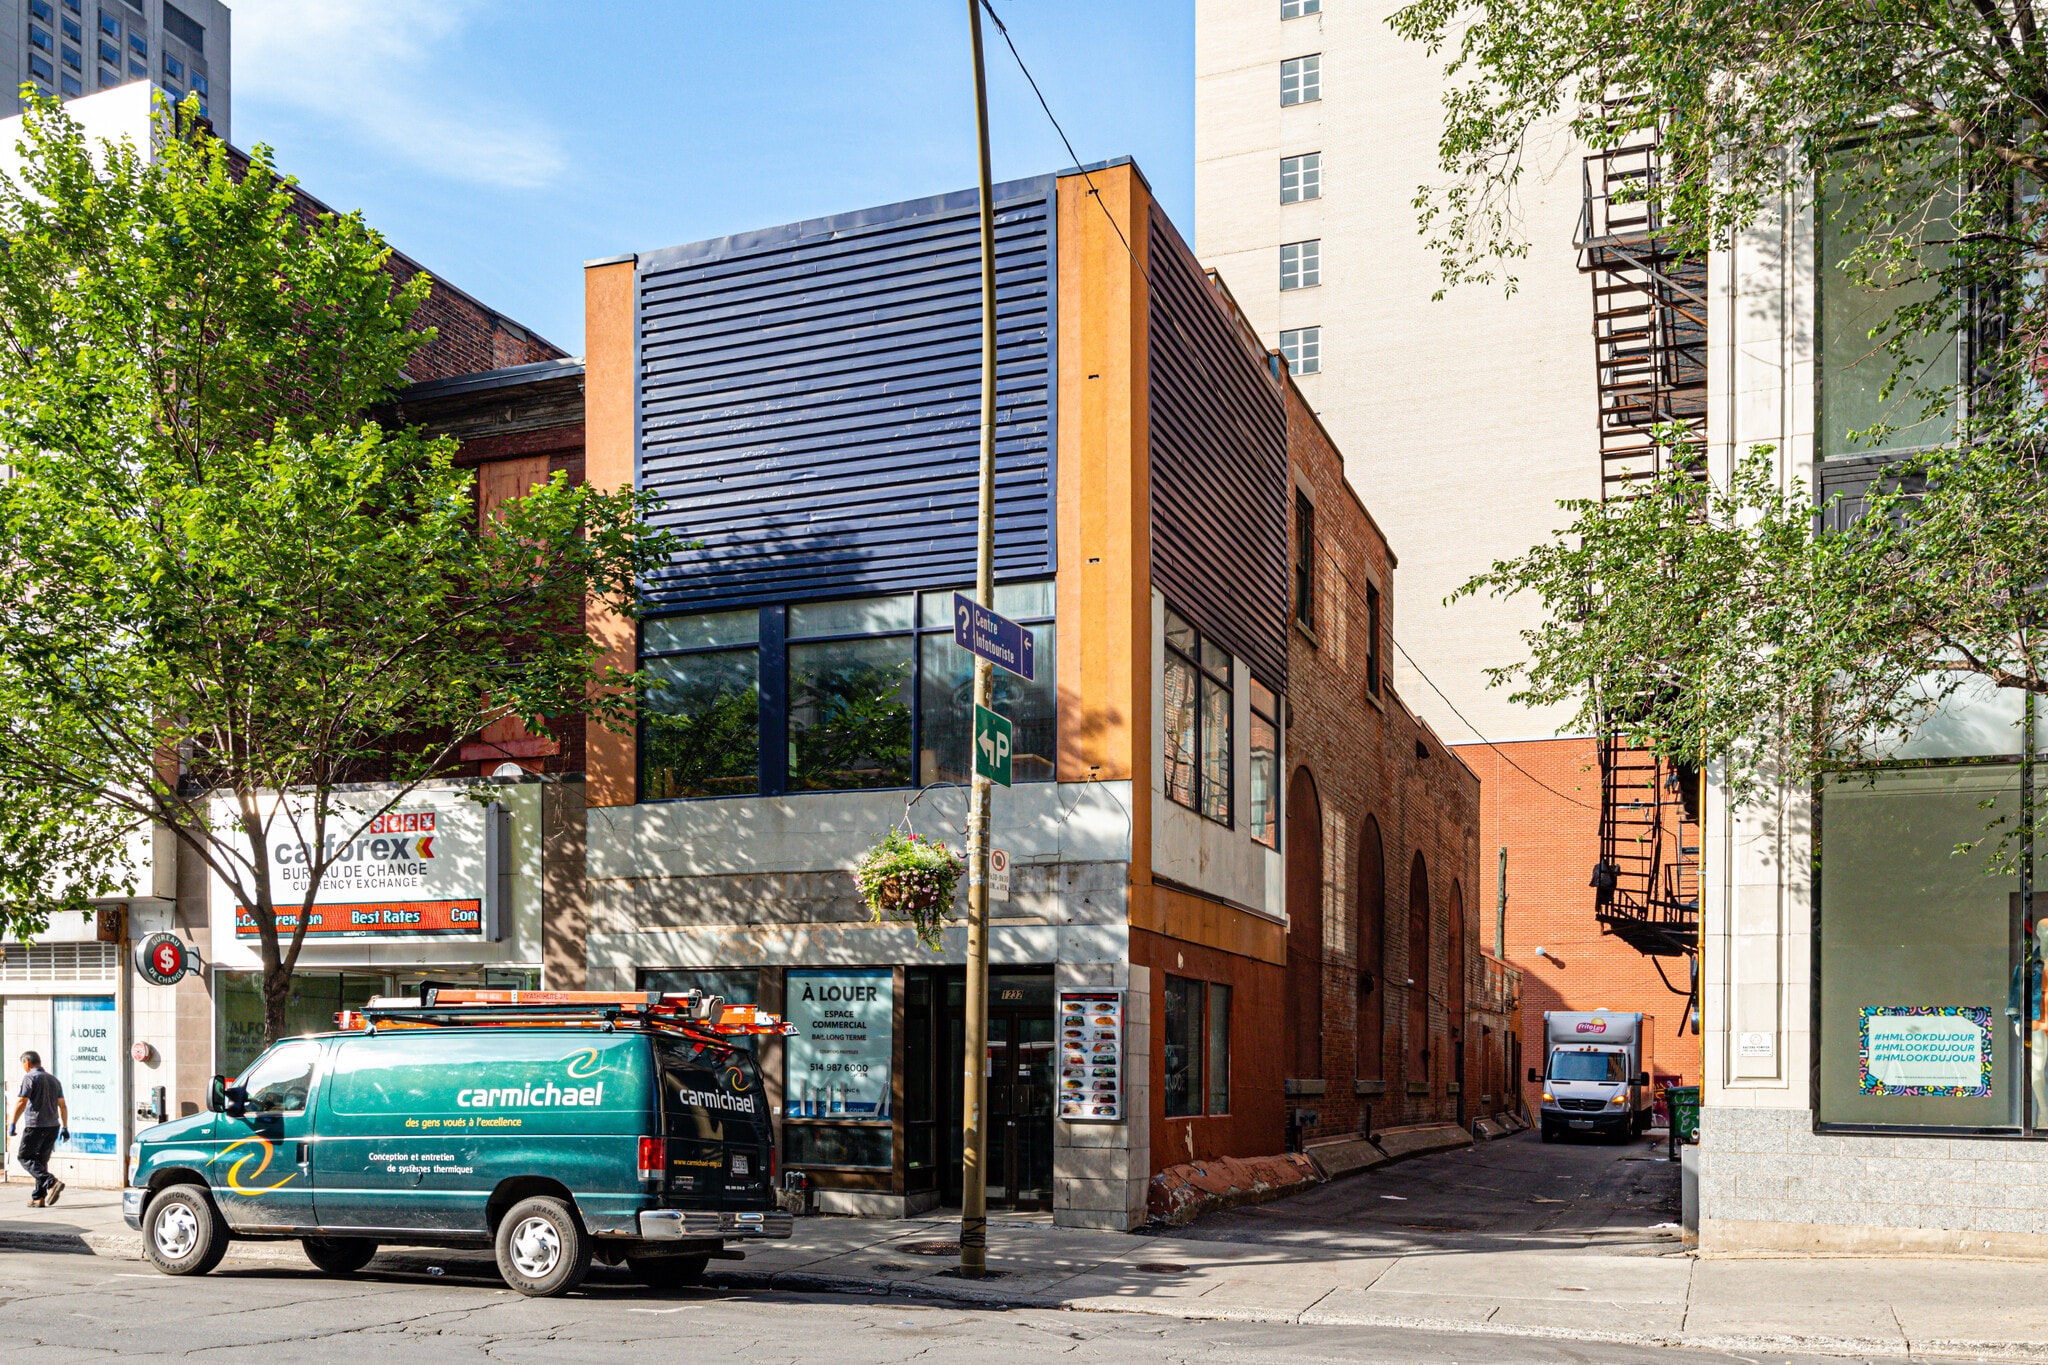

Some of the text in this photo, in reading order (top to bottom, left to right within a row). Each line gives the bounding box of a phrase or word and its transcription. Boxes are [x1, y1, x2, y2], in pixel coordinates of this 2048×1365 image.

[975, 610, 998, 635] Centre
[976, 630, 1015, 665] Infotouriste
[996, 731, 1010, 768] P
[275, 834, 410, 864] caforex
[283, 863, 427, 880] BURAU DE CHANGE
[357, 878, 418, 889] EXCHANGE
[351, 910, 380, 924] Best
[383, 909, 420, 923] Rates
[151, 935, 180, 947] BUREAU
[149, 967, 185, 984] DE CHANGE
[802, 983, 877, 1001] À LOUER
[1002, 989, 1023, 999] 1232
[812, 1021, 867, 1029] COMMERCIAL
[78, 1028, 107, 1038] LOUER
[1874, 1033, 1975, 1042] #HMLOOKDUJOUR
[1874, 1043, 1975, 1052] #HMLOOKDUJOUR
[1875, 1054, 1976, 1063] #HMLOOKDUJOUR
[810, 1063, 869, 1073] 514 987 6000
[457, 1081, 603, 1107] carmichael
[679, 1088, 755, 1114] carmichael
[405, 1116, 522, 1130] des gens voués à l'excellence
[368, 1152, 455, 1162] Conception et entretien
[387, 1164, 474, 1175] de systèmes thermiques
